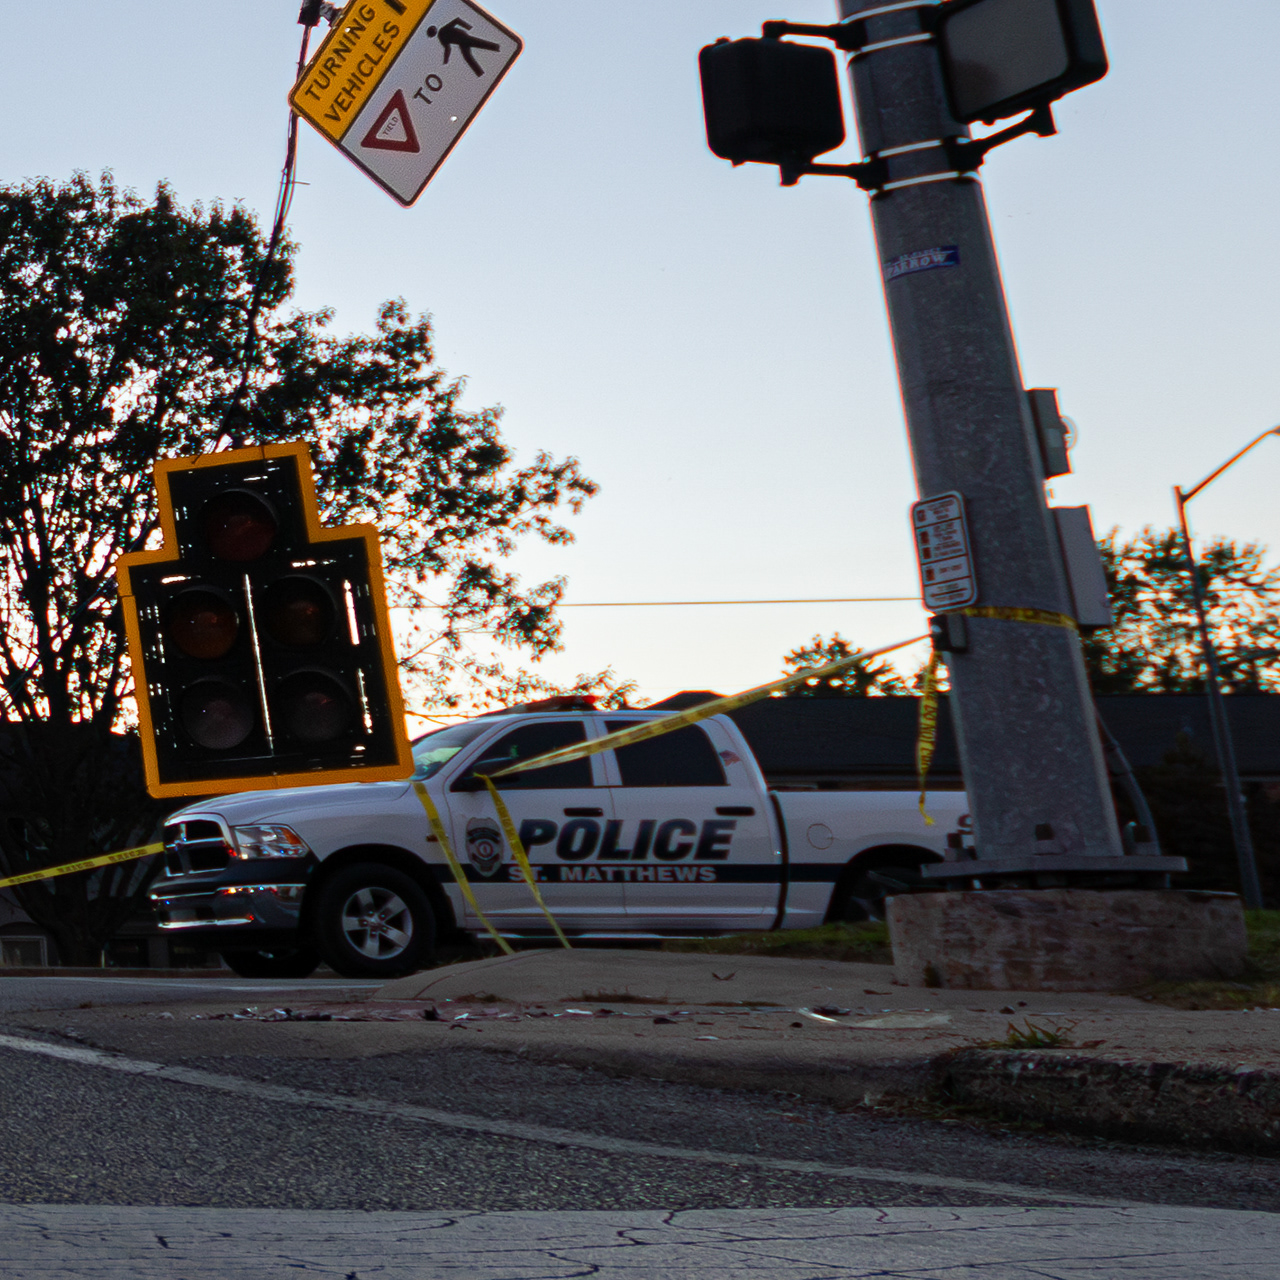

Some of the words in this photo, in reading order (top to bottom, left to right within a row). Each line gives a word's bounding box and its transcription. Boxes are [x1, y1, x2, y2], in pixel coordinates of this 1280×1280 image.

[304, 4, 376, 102] TURNING
[324, 20, 400, 123] VEHICLES
[413, 73, 443, 106] TO
[382, 116, 399, 136] YIELD
[511, 818, 737, 861] POLICE
[560, 866, 718, 882] MATTHEWS
